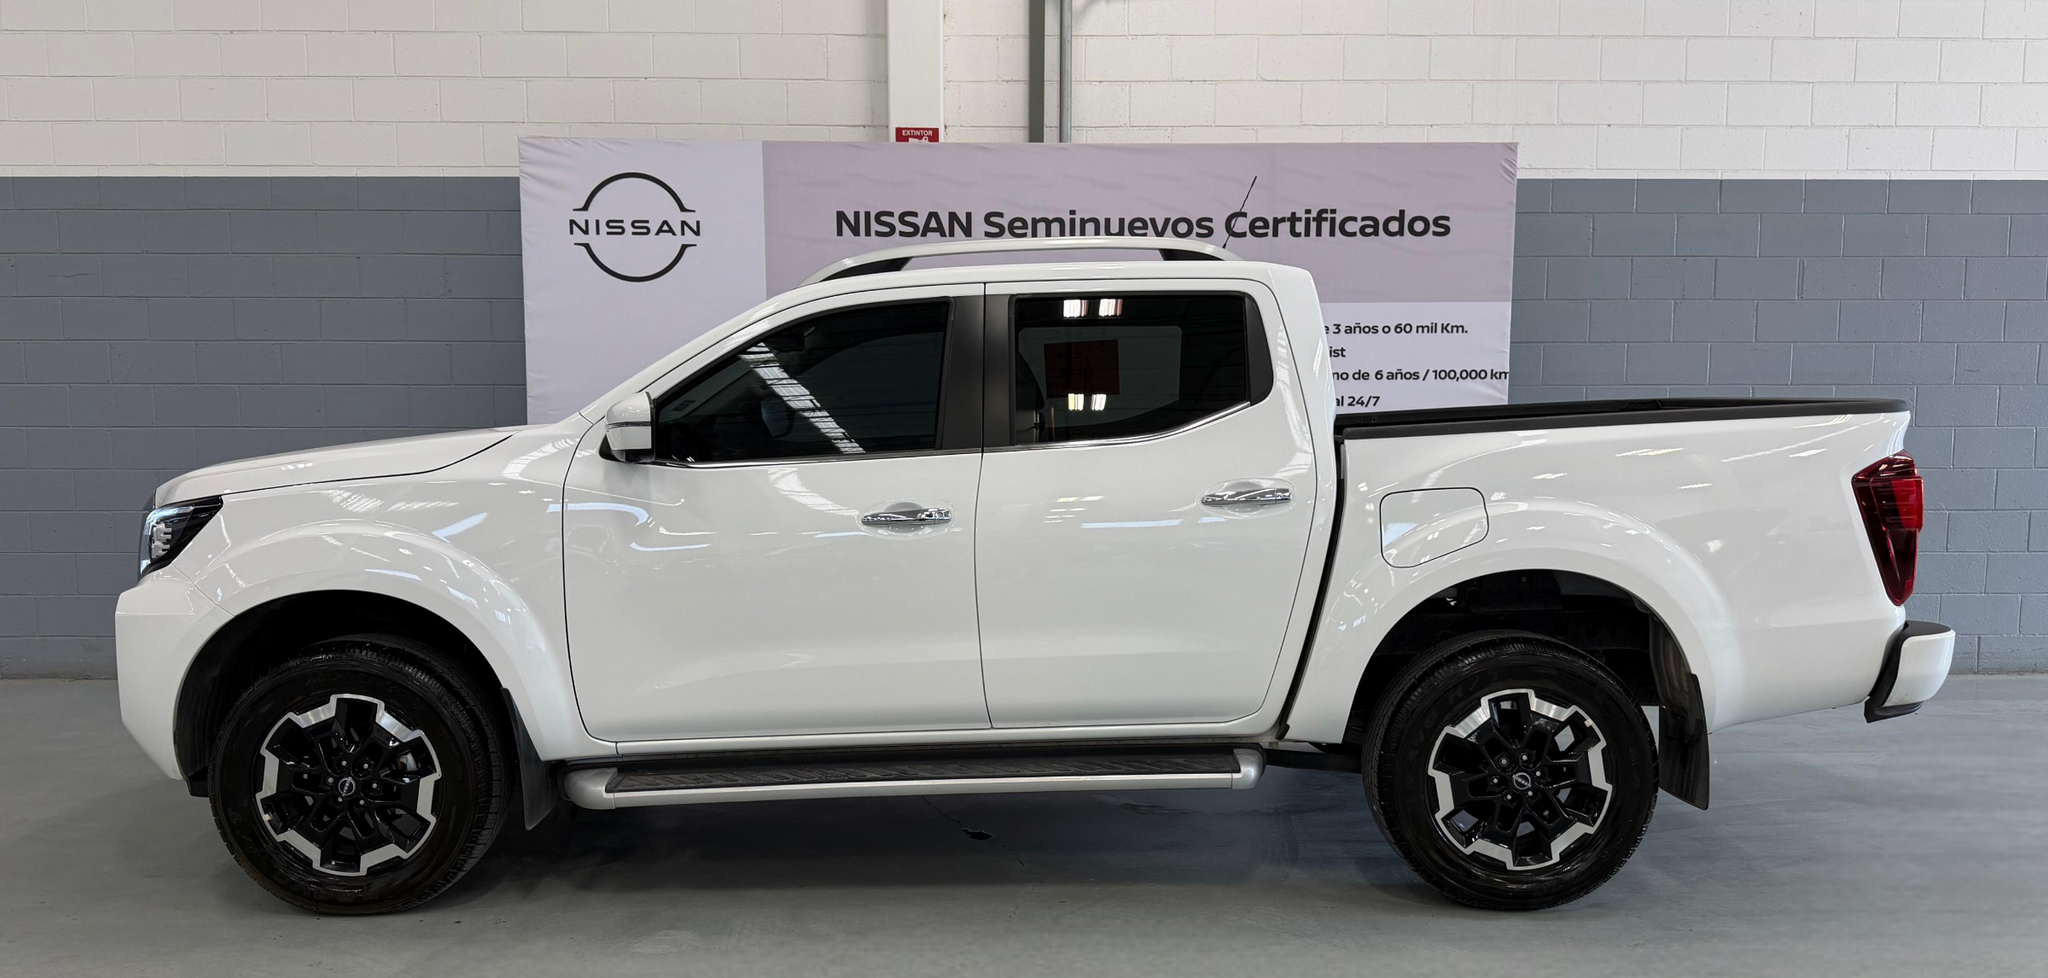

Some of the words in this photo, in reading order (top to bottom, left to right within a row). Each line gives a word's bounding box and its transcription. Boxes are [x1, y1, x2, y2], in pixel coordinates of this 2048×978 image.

[569, 219, 701, 236] NISSAN
[835, 210, 973, 238] NISSAN
[983, 209, 1214, 239] Seminuevos
[1224, 208, 1451, 239] Certificados
[1332, 323, 1342, 335] 3
[1344, 322, 1379, 335] años
[1381, 325, 1392, 335] o
[1393, 322, 1413, 335] 60
[1415, 322, 1438, 334] mil
[1440, 322, 1468, 334] Km.
[1329, 346, 1346, 358] ist
[1352, 369, 1370, 381] de
[1374, 369, 1384, 381] 6
[1386, 368, 1420, 381] años
[1422, 368, 1430, 381] /
[1432, 368, 1488, 382] 100,000
[1347, 395, 1381, 408] 24/7
